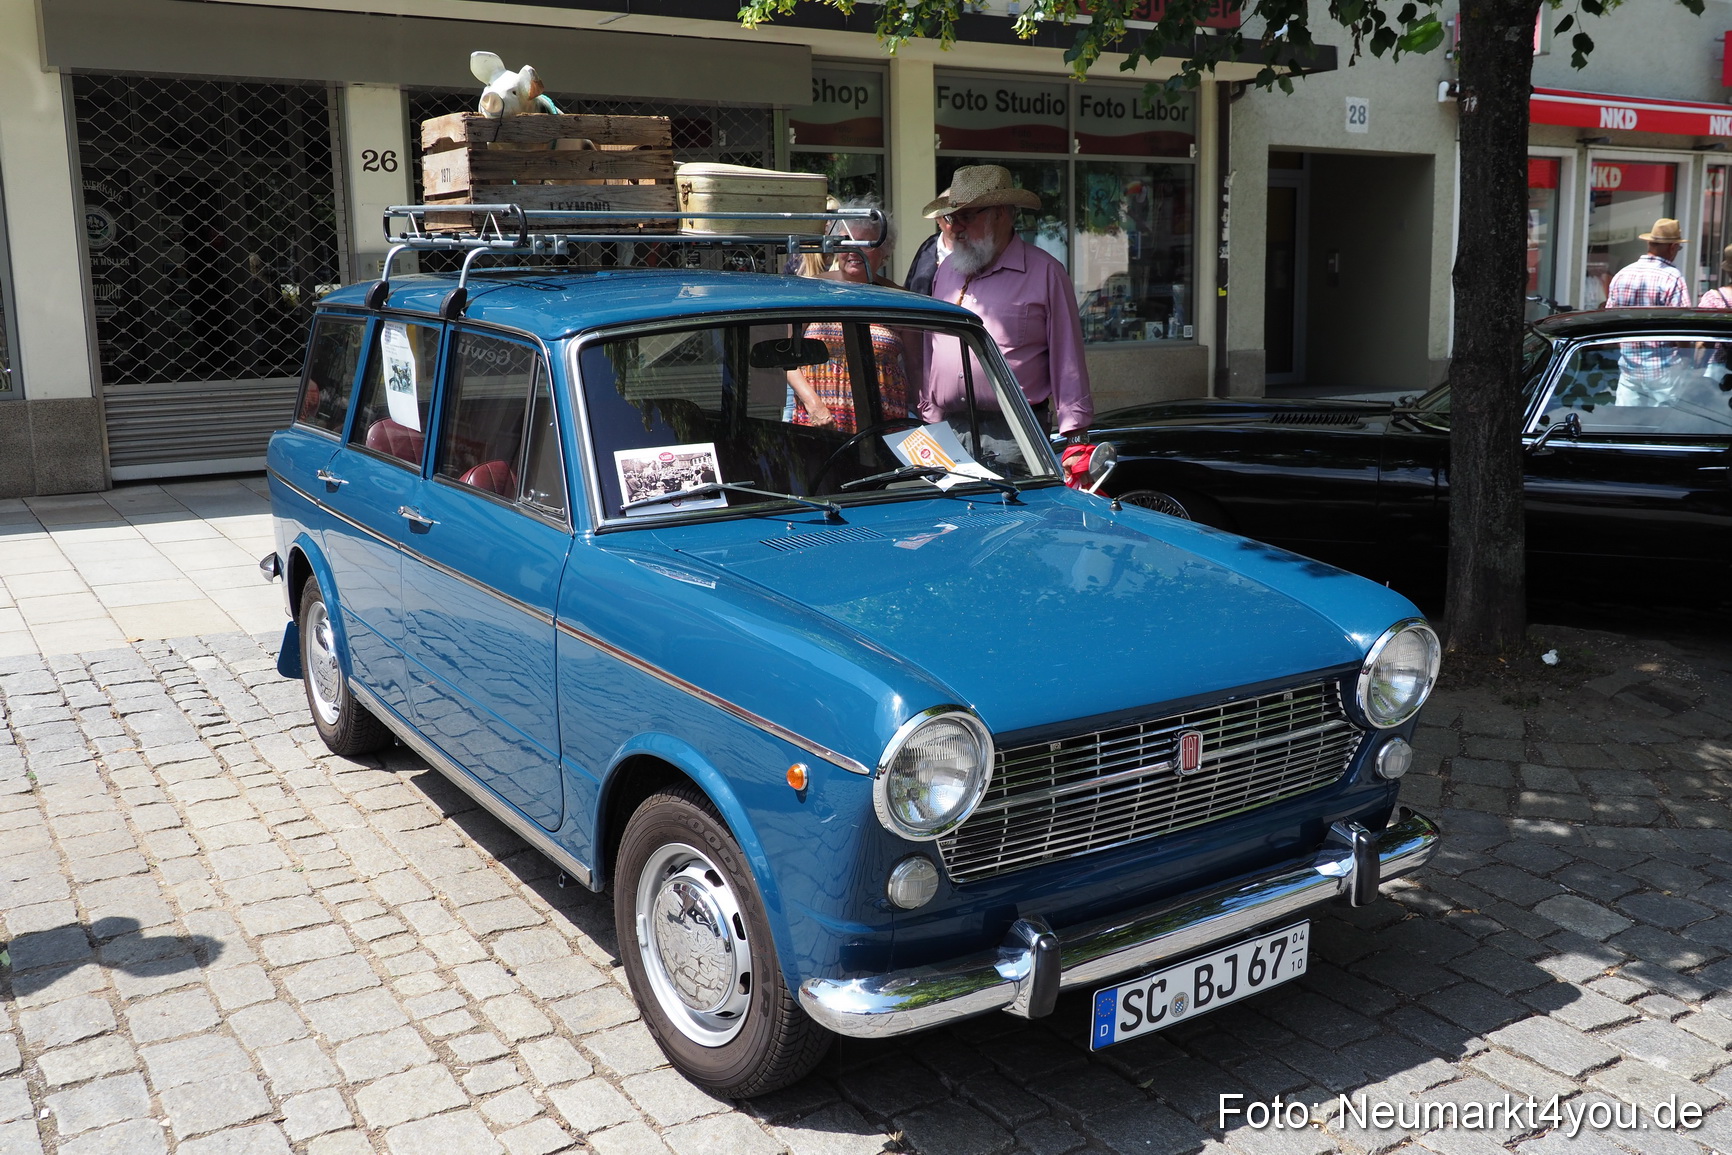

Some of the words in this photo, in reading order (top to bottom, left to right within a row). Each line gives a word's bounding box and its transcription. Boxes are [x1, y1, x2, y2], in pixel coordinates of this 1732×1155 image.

[812, 77, 869, 110] Shop
[937, 85, 988, 111] Foto
[995, 89, 1065, 115] Studio
[1080, 95, 1126, 118] Foto
[1133, 98, 1189, 121] Labor
[1349, 104, 1366, 124] 28
[1600, 107, 1638, 130] NKD
[1709, 115, 1732, 136] NK
[361, 149, 398, 173] 26
[441, 168, 451, 183] 1971
[1182, 736, 1198, 769] FIAT
[1292, 930, 1304, 944] 04
[1291, 959, 1303, 972] 10
[1120, 979, 1167, 1032] SC
[1194, 954, 1238, 1008] BJ
[1248, 936, 1288, 987] 67
[1100, 1024, 1109, 1037] D
